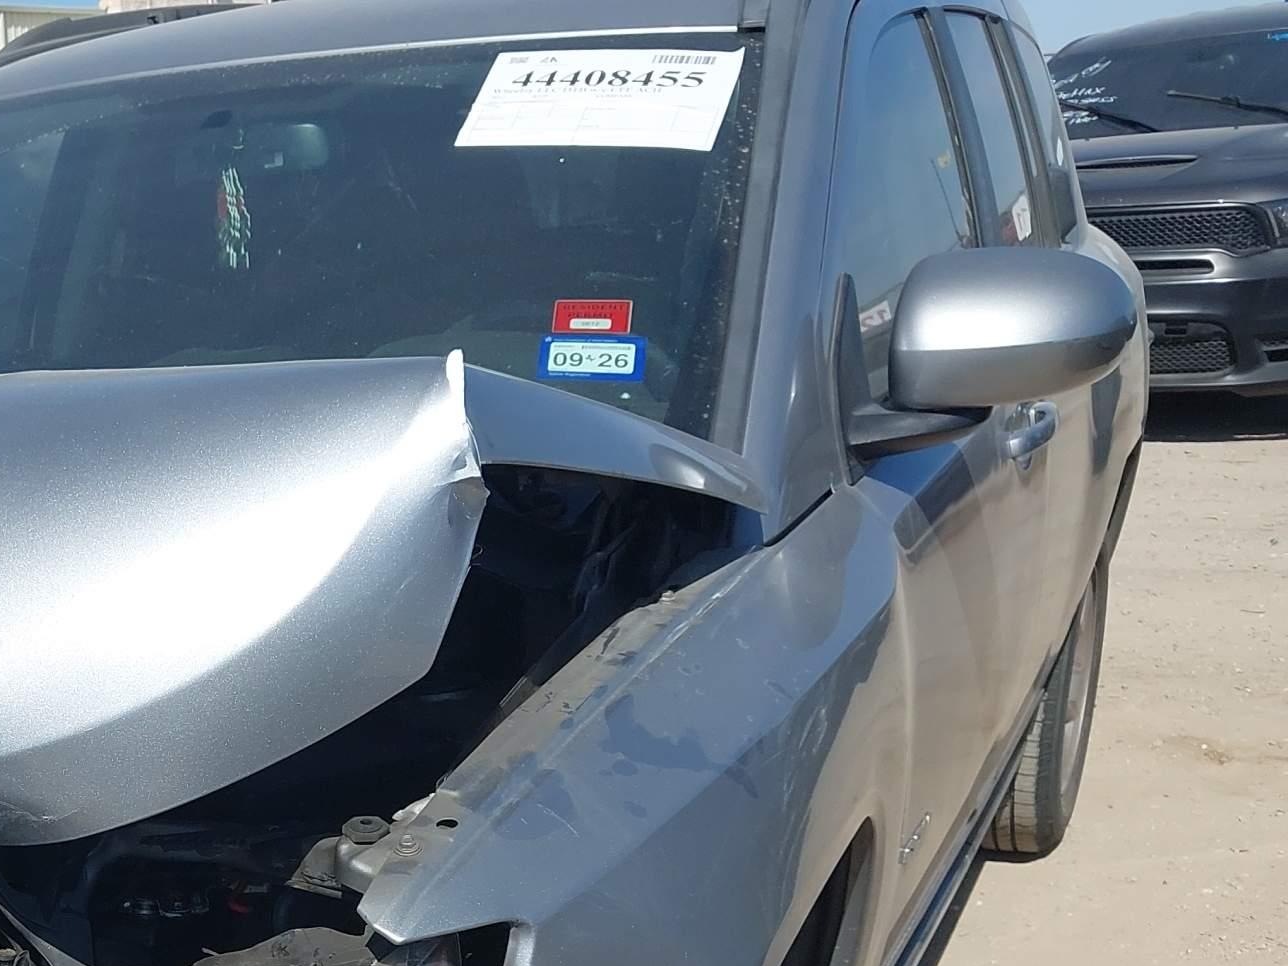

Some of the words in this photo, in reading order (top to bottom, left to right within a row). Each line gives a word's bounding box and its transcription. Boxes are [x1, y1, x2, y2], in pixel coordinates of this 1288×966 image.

[511, 70, 707, 88] 44408455
[553, 352, 583, 367] 09
[598, 353, 629, 368] 26
